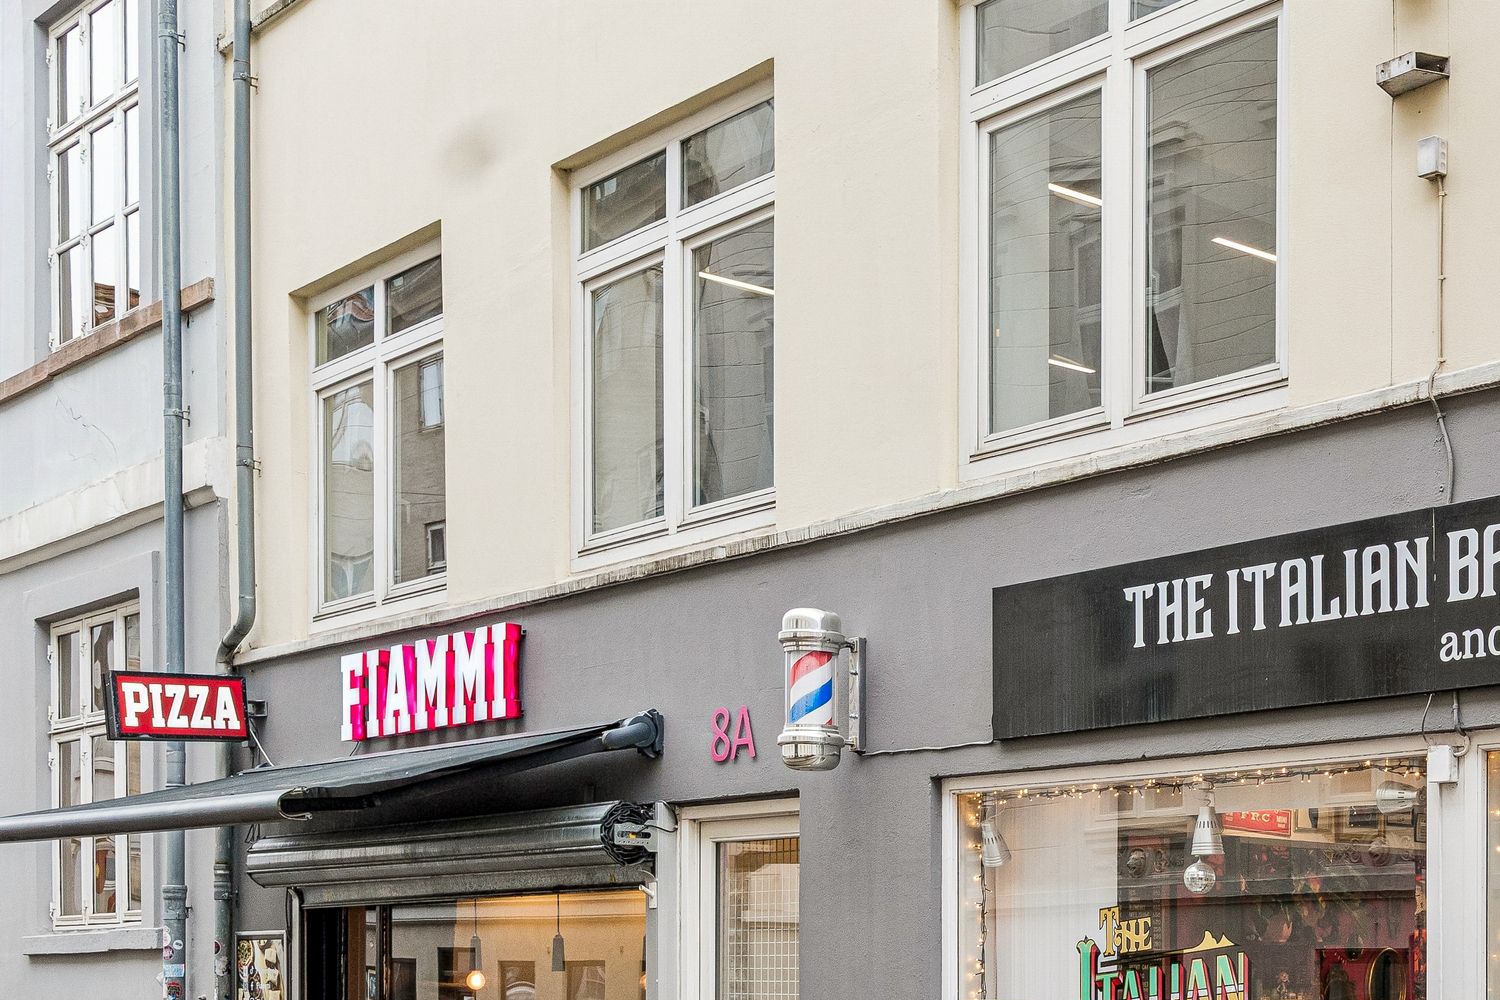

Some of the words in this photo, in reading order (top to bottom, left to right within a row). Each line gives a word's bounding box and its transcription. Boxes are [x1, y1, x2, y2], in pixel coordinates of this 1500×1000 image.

[1123, 574, 1214, 648] THE
[1226, 536, 1430, 634] ITALIAN
[121, 683, 241, 729] PIZZA
[341, 622, 514, 741] FIAMMI
[711, 705, 755, 761] 8A
